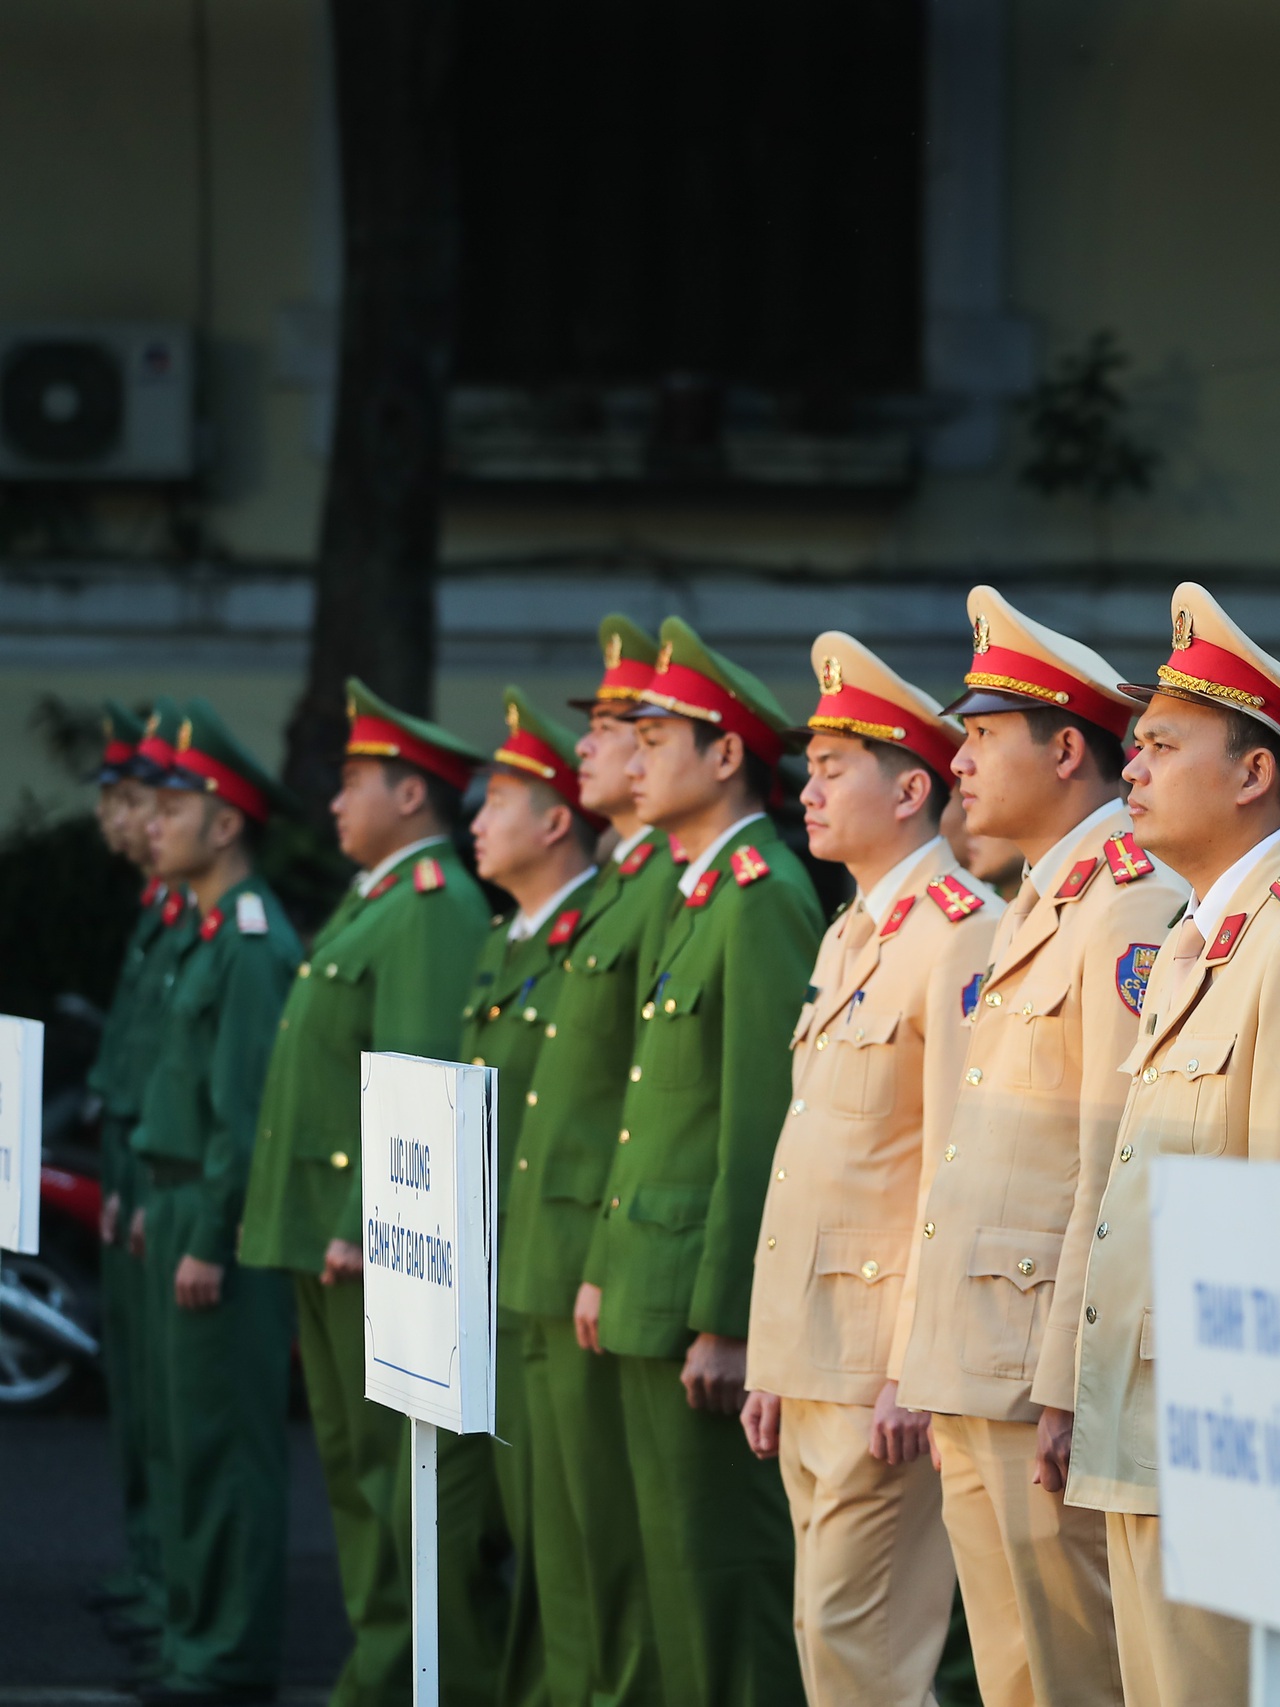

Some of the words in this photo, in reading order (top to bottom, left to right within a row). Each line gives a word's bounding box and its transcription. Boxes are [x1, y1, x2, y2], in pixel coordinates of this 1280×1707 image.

[390, 1134, 404, 1194] LỰC
[405, 1138, 430, 1200] LƯỢNG
[368, 1206, 390, 1269] CẢNH
[391, 1212, 405, 1273] SÁT
[406, 1229, 425, 1280] GIAO
[426, 1224, 453, 1289] THÔNG
